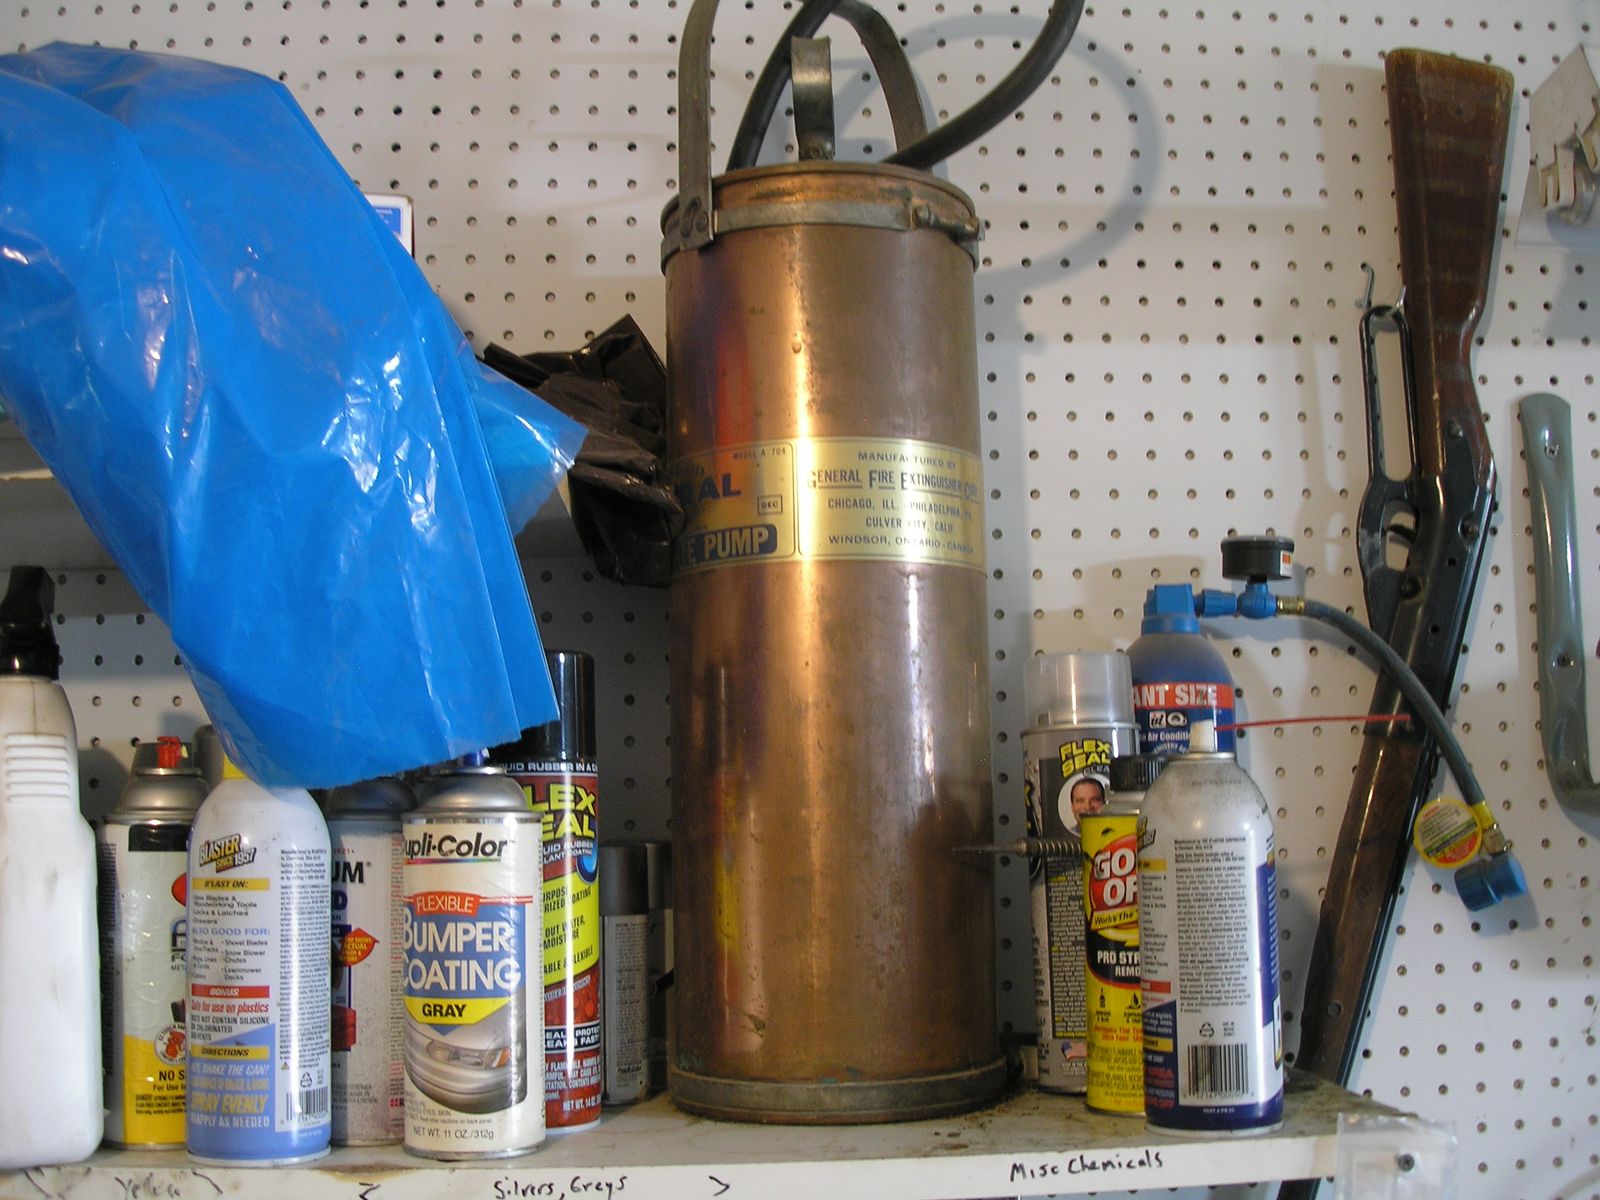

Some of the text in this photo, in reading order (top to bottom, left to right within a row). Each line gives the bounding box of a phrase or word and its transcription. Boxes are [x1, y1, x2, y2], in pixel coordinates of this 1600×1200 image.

[808, 469, 862, 489] GENERAL
[869, 470, 895, 489] FIRE
[901, 471, 961, 491] EXTINGUISHER
[866, 517, 902, 529] CULVER
[703, 526, 769, 560] PUMP
[828, 535, 891, 547] WINDSOR,
[1175, 683, 1217, 706] SIZE
[1059, 739, 1111, 762] FLEX
[503, 762, 525, 772] UID
[528, 762, 574, 772] RUBBER
[1061, 751, 1111, 779] SEAL
[235, 847, 257, 866] 1957
[569, 848, 593, 858] OATING
[415, 894, 475, 914] FLEXIBLE
[1095, 911, 1134, 925] Works The
[211, 927, 241, 936] GOOD
[403, 907, 512, 953] BUMPER
[545, 925, 560, 938] OUT
[543, 928, 580, 950] MOISTRE
[574, 944, 594, 964] LEXIBLE
[1097, 949, 1117, 965] PRO
[212, 1004, 224, 1013] use
[237, 1001, 270, 1016] plastics
[421, 1003, 468, 1018] GRAY
[212, 1016, 238, 1024] CONTAIN
[201, 1047, 250, 1057] DIRECTIONS
[158, 1070, 175, 1081] NO
[227, 1064, 245, 1076] THE
[246, 1064, 270, 1076] CAN!
[218, 1116, 230, 1127] AS
[232, 1116, 270, 1128] NEEDED
[413, 1125, 426, 1137] NET
[444, 1128, 451, 1138] 11
[1009, 1149, 1164, 1183] Misc Chemicals
